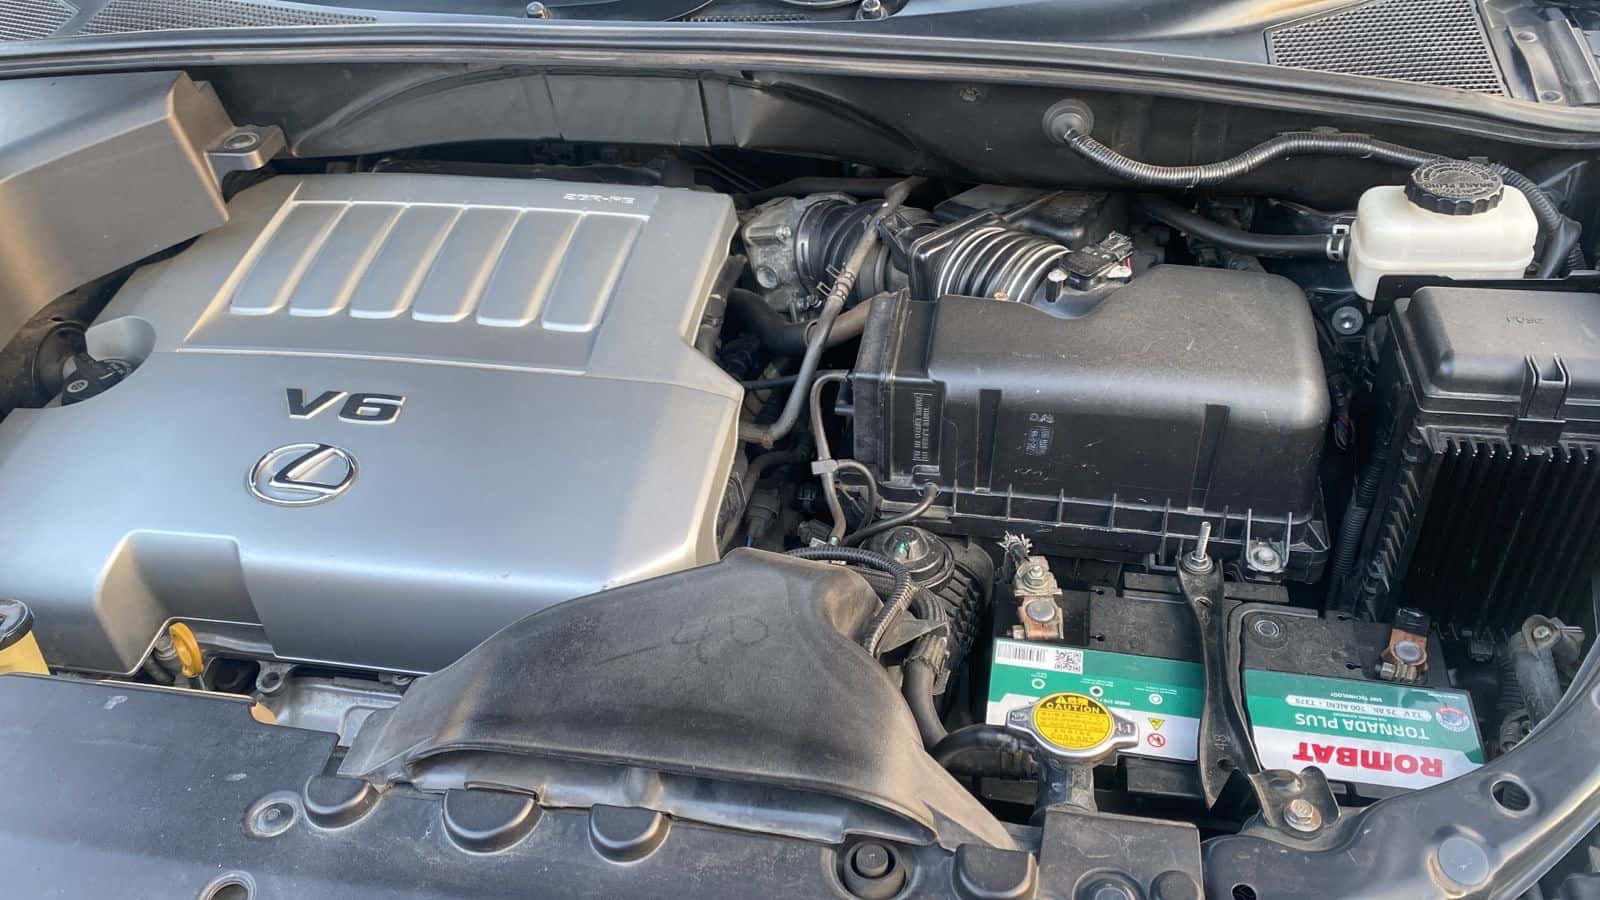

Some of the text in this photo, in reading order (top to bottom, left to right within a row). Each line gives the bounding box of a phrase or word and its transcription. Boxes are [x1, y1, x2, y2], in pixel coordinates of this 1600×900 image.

[286, 388, 406, 425] V6
[1045, 701, 1101, 715] CAUTION
[1295, 713, 1339, 729] PLUS
[1343, 719, 1431, 740] TORNADA
[1292, 741, 1444, 777] ROMBAT
